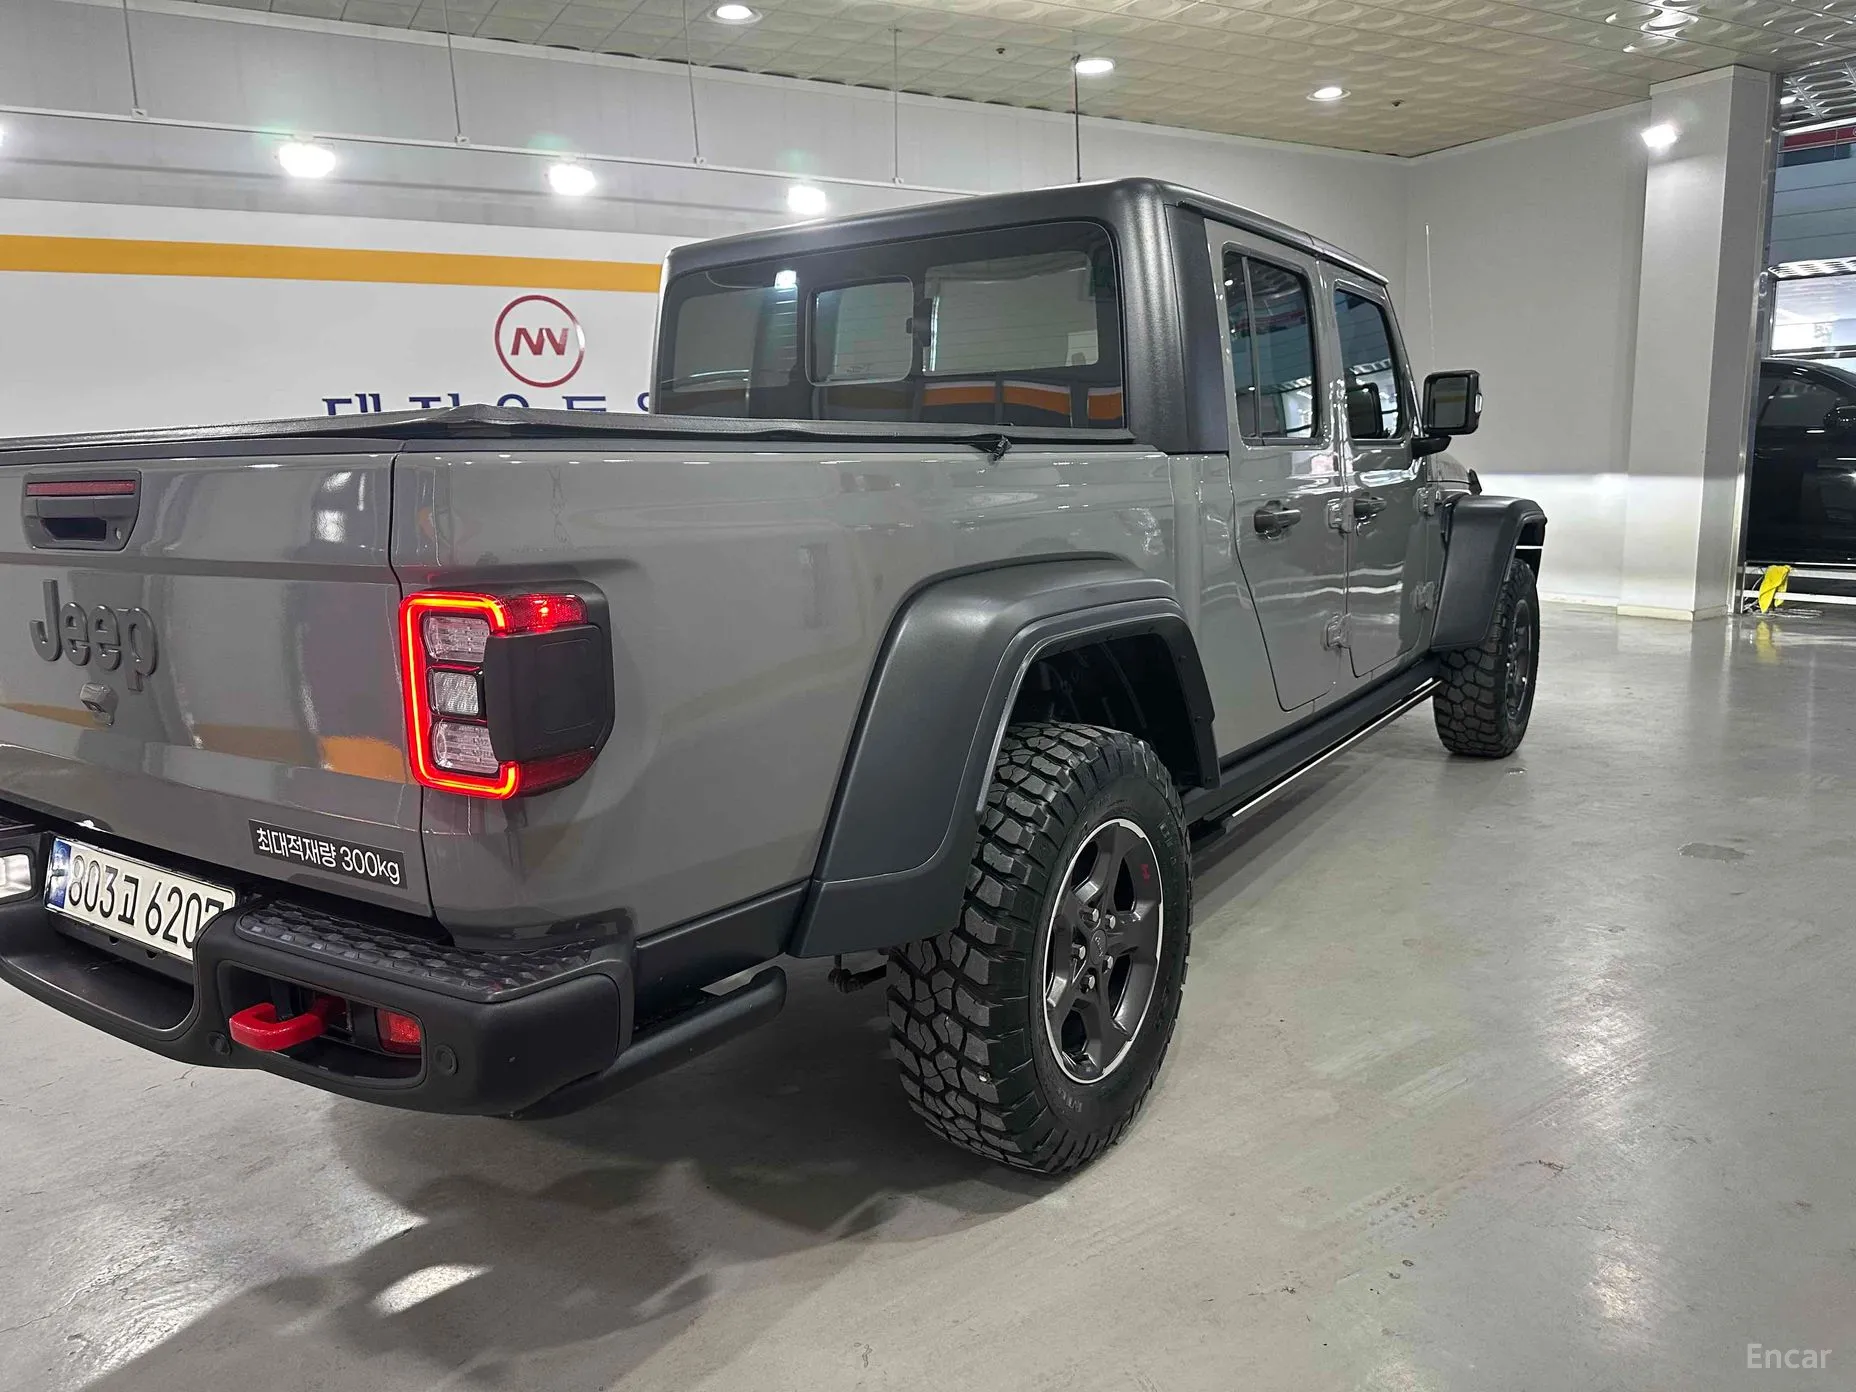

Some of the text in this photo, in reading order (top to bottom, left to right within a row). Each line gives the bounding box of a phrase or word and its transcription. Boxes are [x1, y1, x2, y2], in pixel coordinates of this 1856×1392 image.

[29, 578, 159, 693] Jeep
[68, 854, 140, 926] 803고
[256, 827, 401, 885] 최대적재량 300kg
